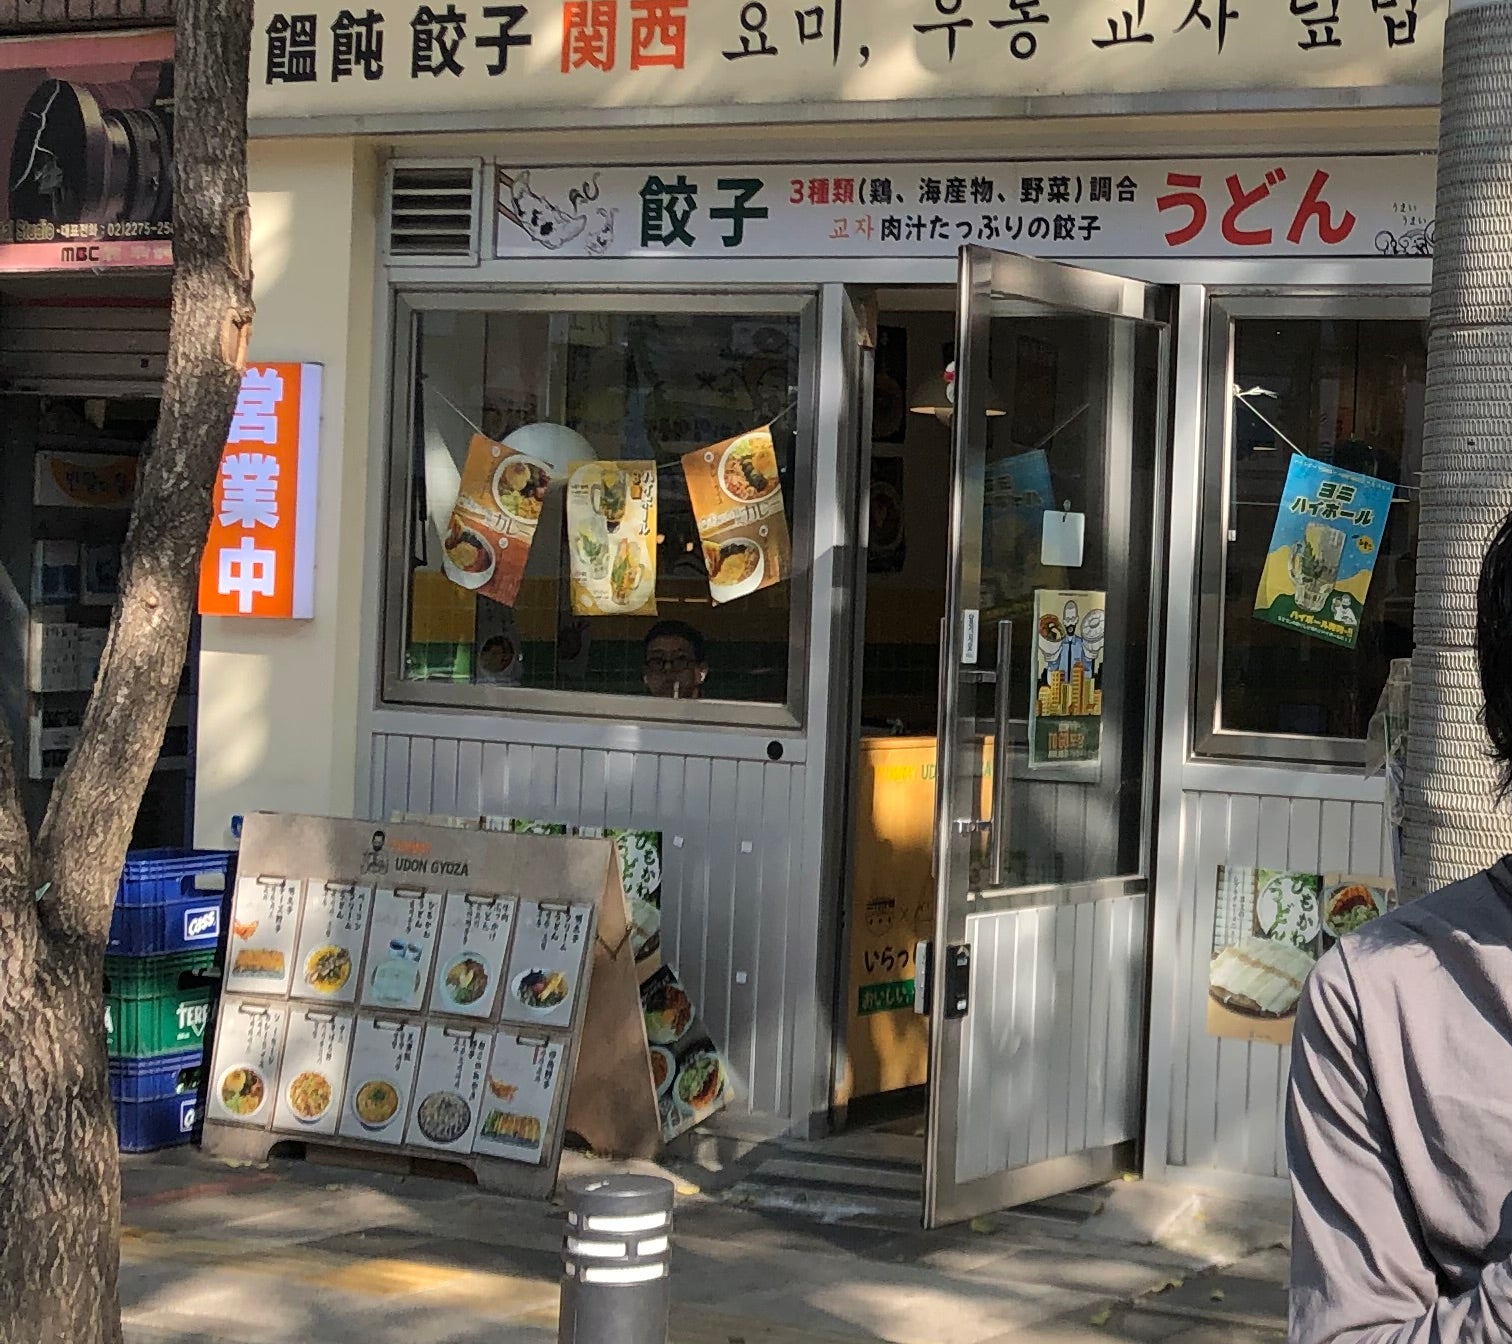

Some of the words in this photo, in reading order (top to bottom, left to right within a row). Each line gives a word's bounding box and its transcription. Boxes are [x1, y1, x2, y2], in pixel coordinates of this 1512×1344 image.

[265, 8, 385, 86] 饂飩
[409, 2, 533, 79] 餃子
[637, 174, 769, 249] 餃子
[1155, 166, 1356, 248] うどん
[217, 367, 284, 614] 営業中
[1317, 480, 1357, 503] ヨミ
[395, 857, 428, 874] UDON
[431, 860, 469, 876] GYOZA
